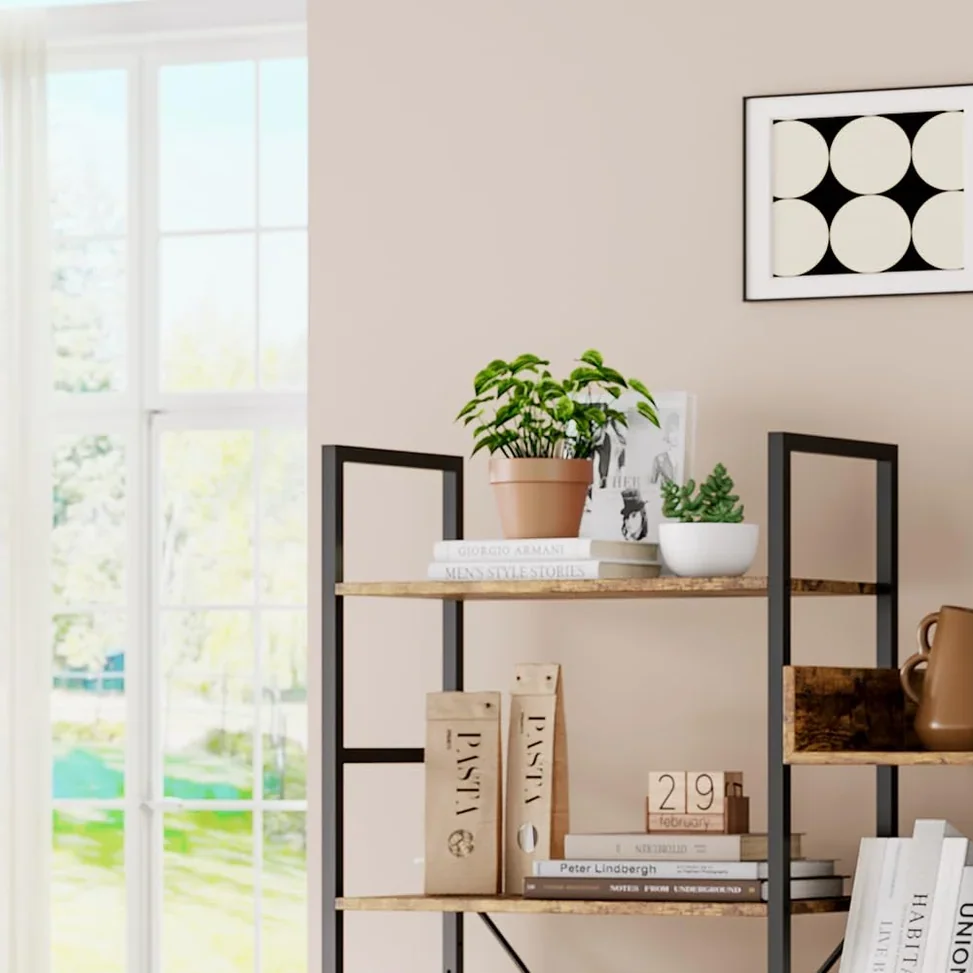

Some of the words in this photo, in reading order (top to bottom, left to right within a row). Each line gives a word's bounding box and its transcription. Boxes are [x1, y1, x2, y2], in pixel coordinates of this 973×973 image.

[457, 545, 510, 557] GIORGIO
[515, 544, 564, 556] ARMANI
[486, 566, 527, 579] STYLE
[530, 564, 586, 578] STORIES
[524, 715, 546, 804] PASTA
[456, 732, 481, 816] PASTA
[659, 816, 710, 832] february
[560, 863, 591, 873] Peter
[595, 863, 657, 877] Lindbergh
[609, 884, 639, 892] NOTES
[644, 884, 669, 893] FROM
[674, 884, 742, 894] UNDERGROUND
